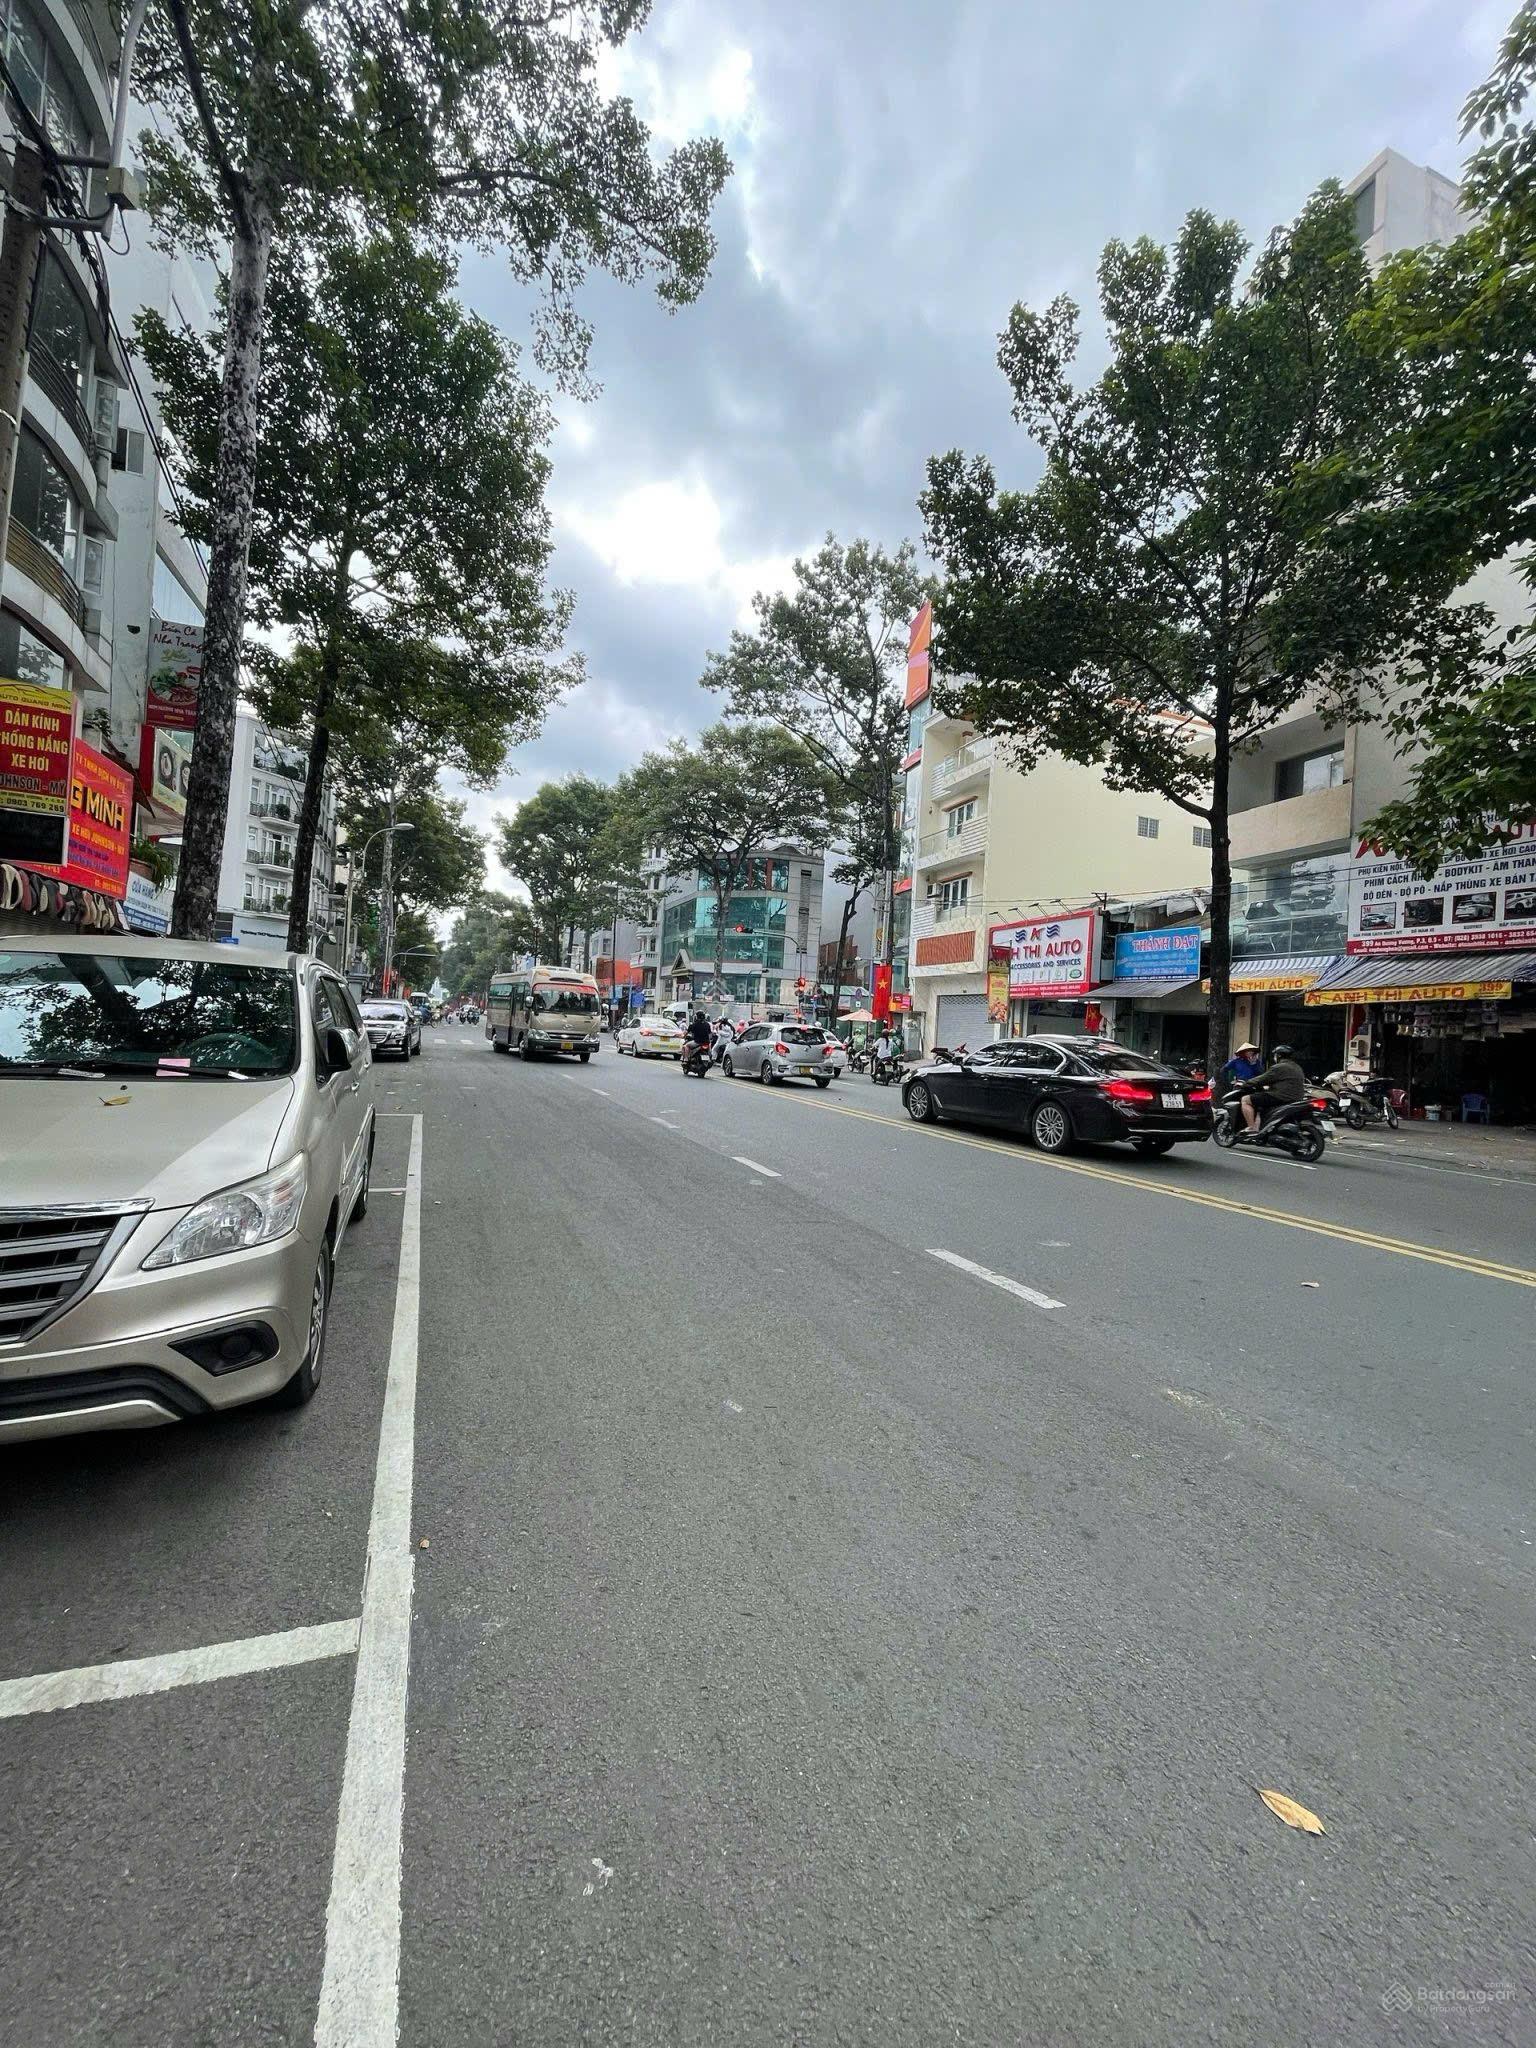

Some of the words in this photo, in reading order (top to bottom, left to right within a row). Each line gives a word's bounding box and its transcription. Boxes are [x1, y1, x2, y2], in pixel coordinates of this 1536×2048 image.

[153, 633, 172, 645] Nha
[5, 708, 29, 727] DÁN
[32, 713, 60, 732] KÍNH
[0, 729, 34, 749] HỐNG
[11, 753, 26, 768] XE
[28, 756, 50, 772] HƠI
[0, 772, 41, 791] OHNSON
[86, 785, 125, 832] MINH
[1488, 850, 1500, 858] XE
[1445, 864, 1484, 878] BODYKIT
[1512, 857, 1536, 869] THAN
[1364, 877, 1385, 888] PHIM
[1387, 873, 1409, 885] CÁCH
[1489, 876, 1502, 887] XE
[1023, 944, 1040, 959] THI
[1045, 939, 1082, 957] AUTO
[1043, 960, 1054, 968] AND
[1056, 957, 1081, 967] SERVICES
[1229, 983, 1244, 991] NH
[1247, 981, 1265, 991] THI
[1269, 979, 1303, 990] AUTO
[1332, 991, 1368, 1003] ANH
[1373, 988, 1402, 1001] THI
[1409, 986, 1465, 1000] AUTO
